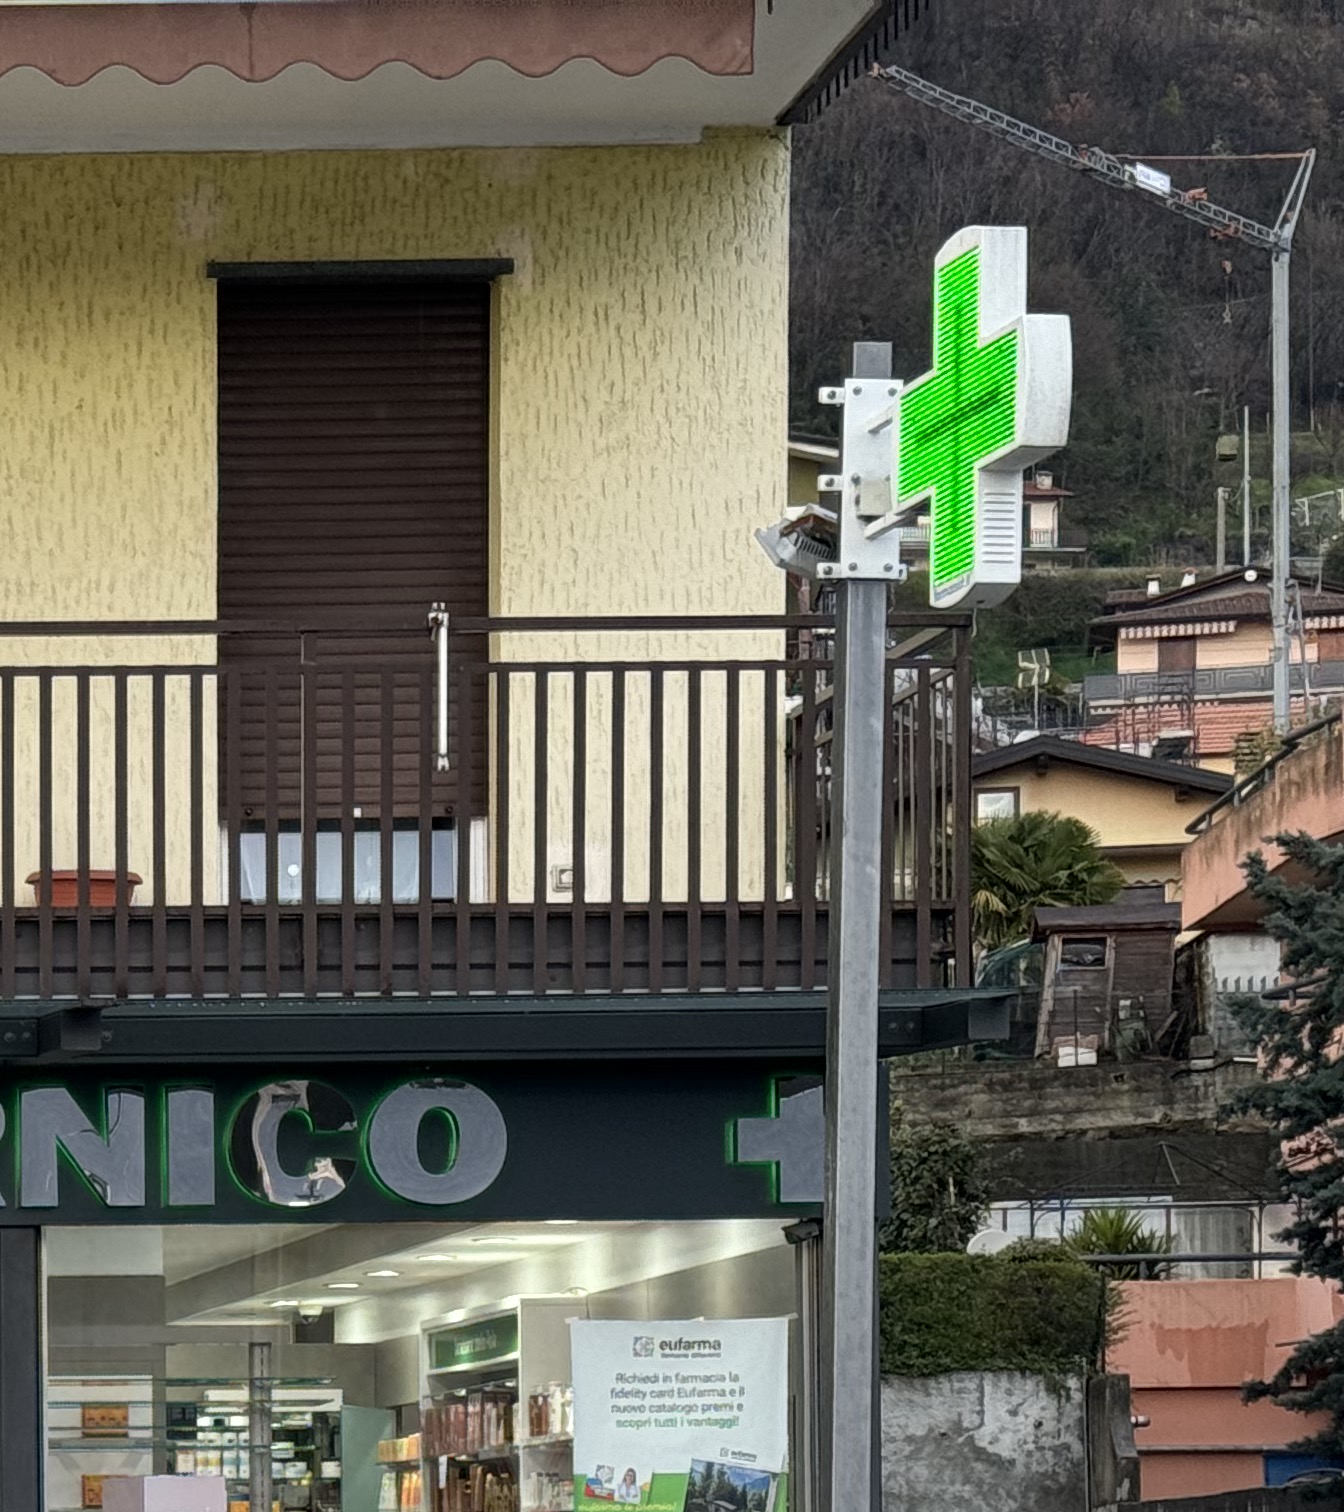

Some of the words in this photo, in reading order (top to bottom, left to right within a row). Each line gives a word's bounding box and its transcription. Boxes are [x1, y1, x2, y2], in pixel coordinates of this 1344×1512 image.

[658, 1337, 722, 1351] eufarma
[615, 1372, 660, 1384] Richiedi
[662, 1373, 672, 1383] in
[675, 1372, 727, 1384] farmacia
[728, 1371, 740, 1383] la
[610, 1388, 647, 1400] fidelity
[649, 1387, 675, 1398] card
[677, 1387, 727, 1398] Eufarma
[611, 1405, 646, 1414] nuovo
[648, 1402, 698, 1415] catalogo
[701, 1403, 734, 1415] premi
[736, 1404, 744, 1412] e
[615, 1418, 652, 1430] scopri
[654, 1418, 677, 1428] tutti
[686, 1416, 740, 1430] vantaggi!
